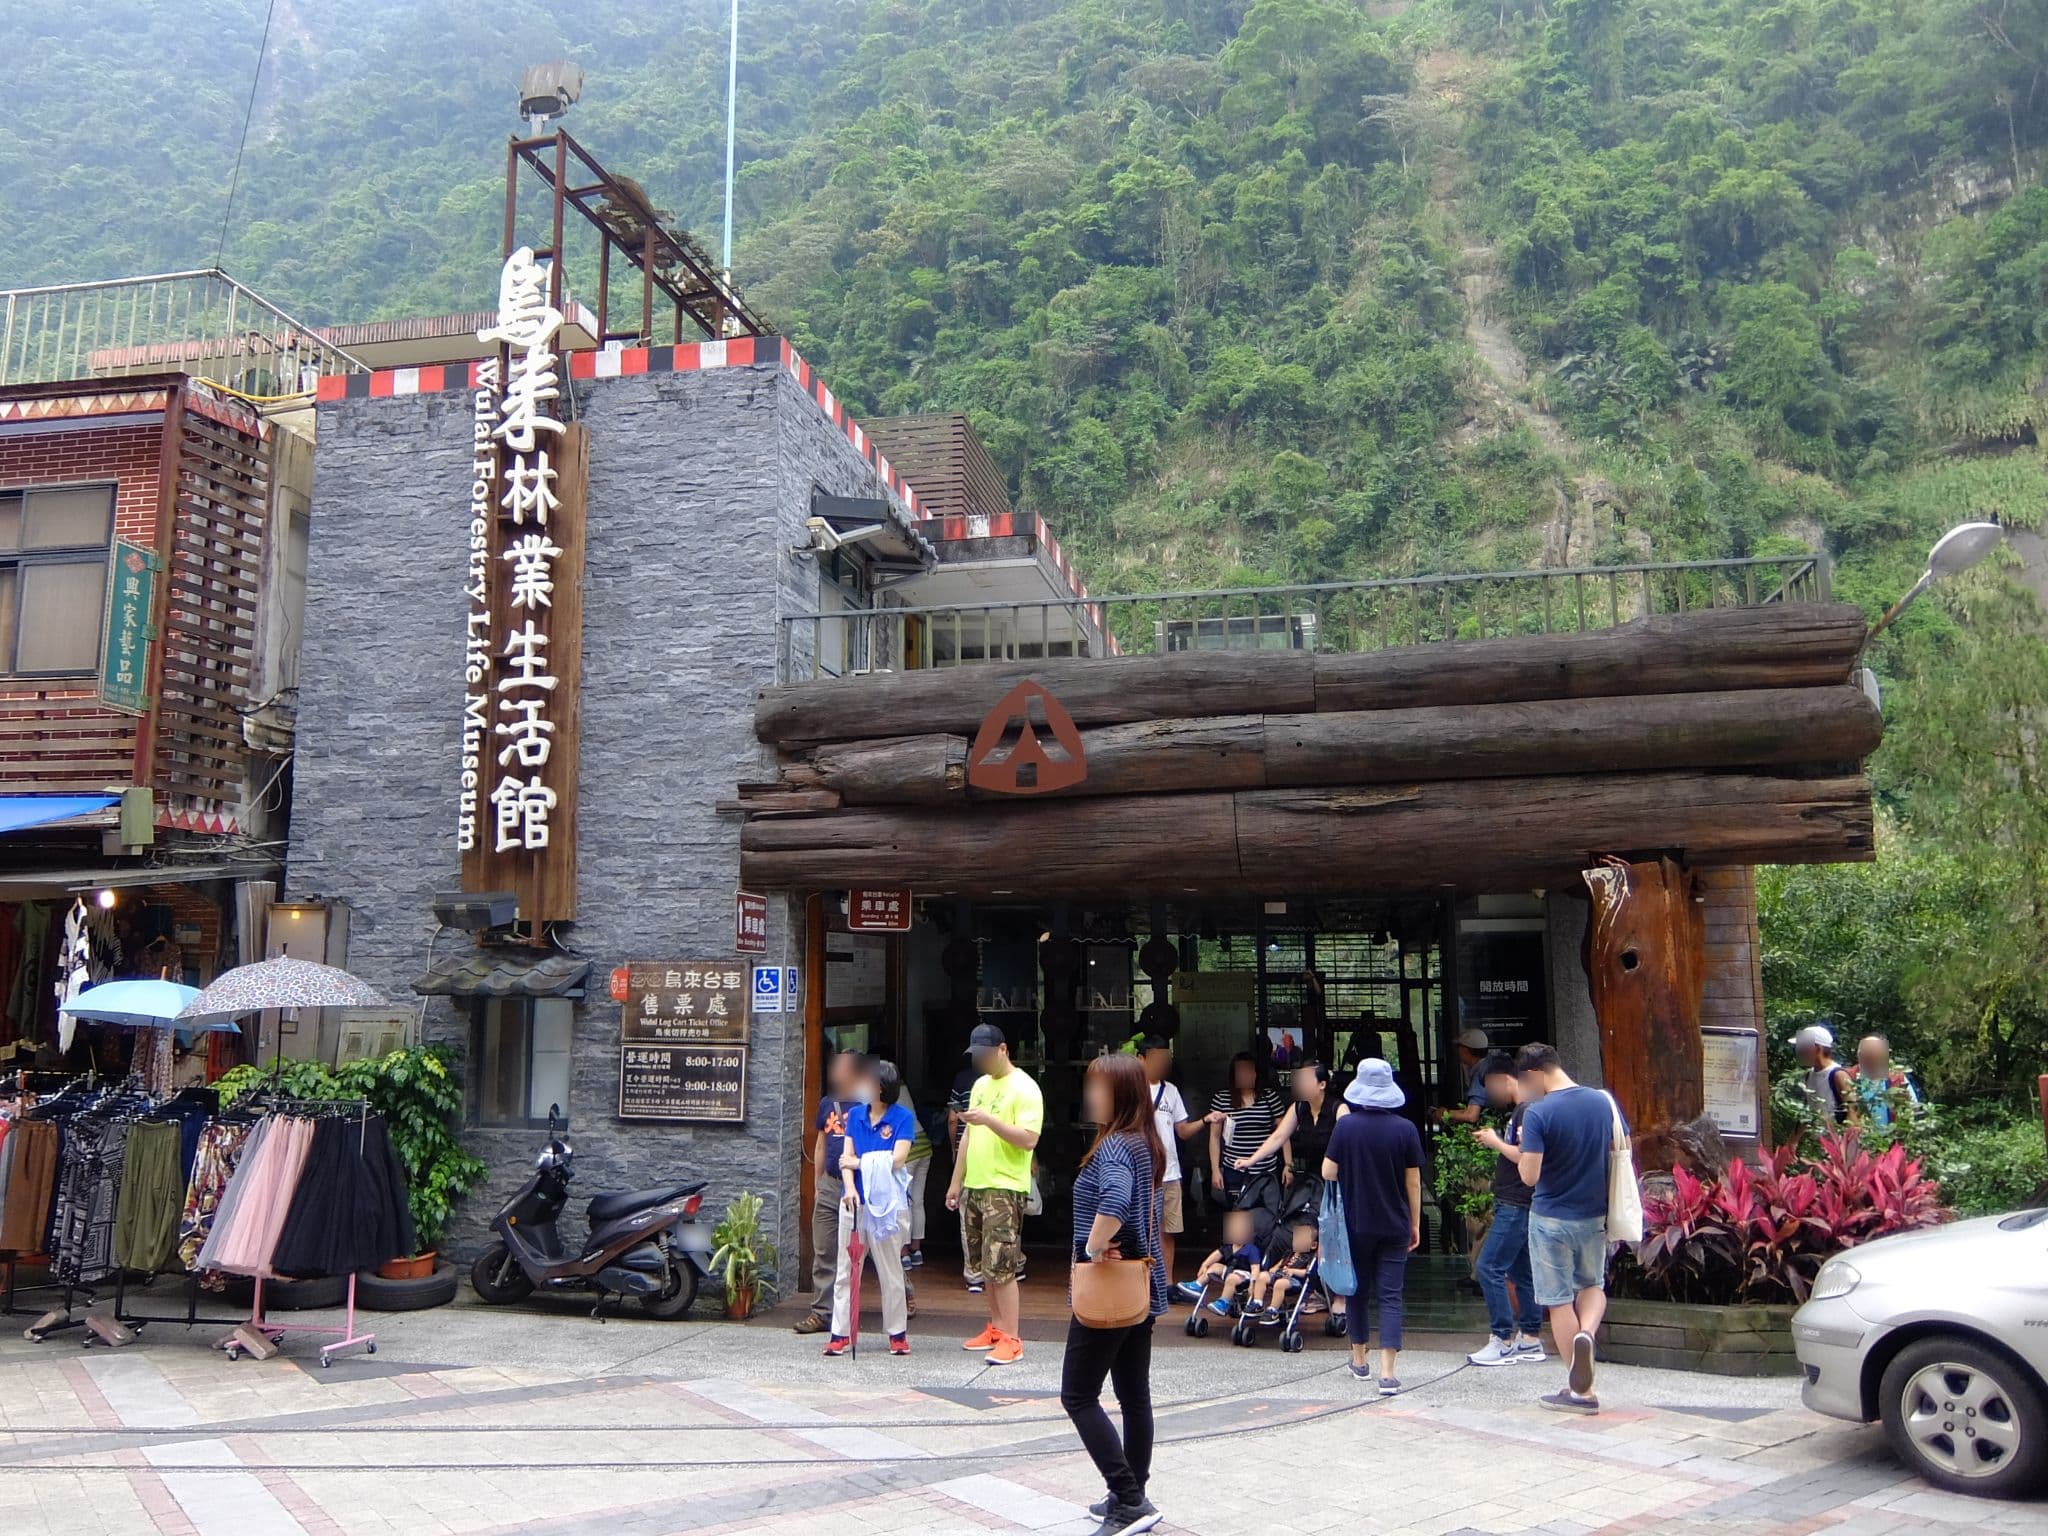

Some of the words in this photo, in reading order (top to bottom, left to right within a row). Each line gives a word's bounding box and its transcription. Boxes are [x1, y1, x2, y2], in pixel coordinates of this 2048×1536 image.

[474, 357, 499, 453] Wulai
[463, 456, 496, 603] Forestry
[477, 246, 567, 853] 烏來林業生活館
[466, 611, 491, 684] Life
[457, 694, 489, 853] Museum
[665, 970, 741, 989] 烏來台車
[1480, 981, 1528, 993] 開放時間
[641, 993, 729, 1016] 售票處
[659, 1018, 672, 1027] Log
[673, 1018, 687, 1026] Cart
[689, 1018, 708, 1026] Ticket
[709, 1019, 729, 1027] Office
[685, 1056, 739, 1068] 8:00-17:00
[685, 1081, 738, 1092] 9:00-18:00
